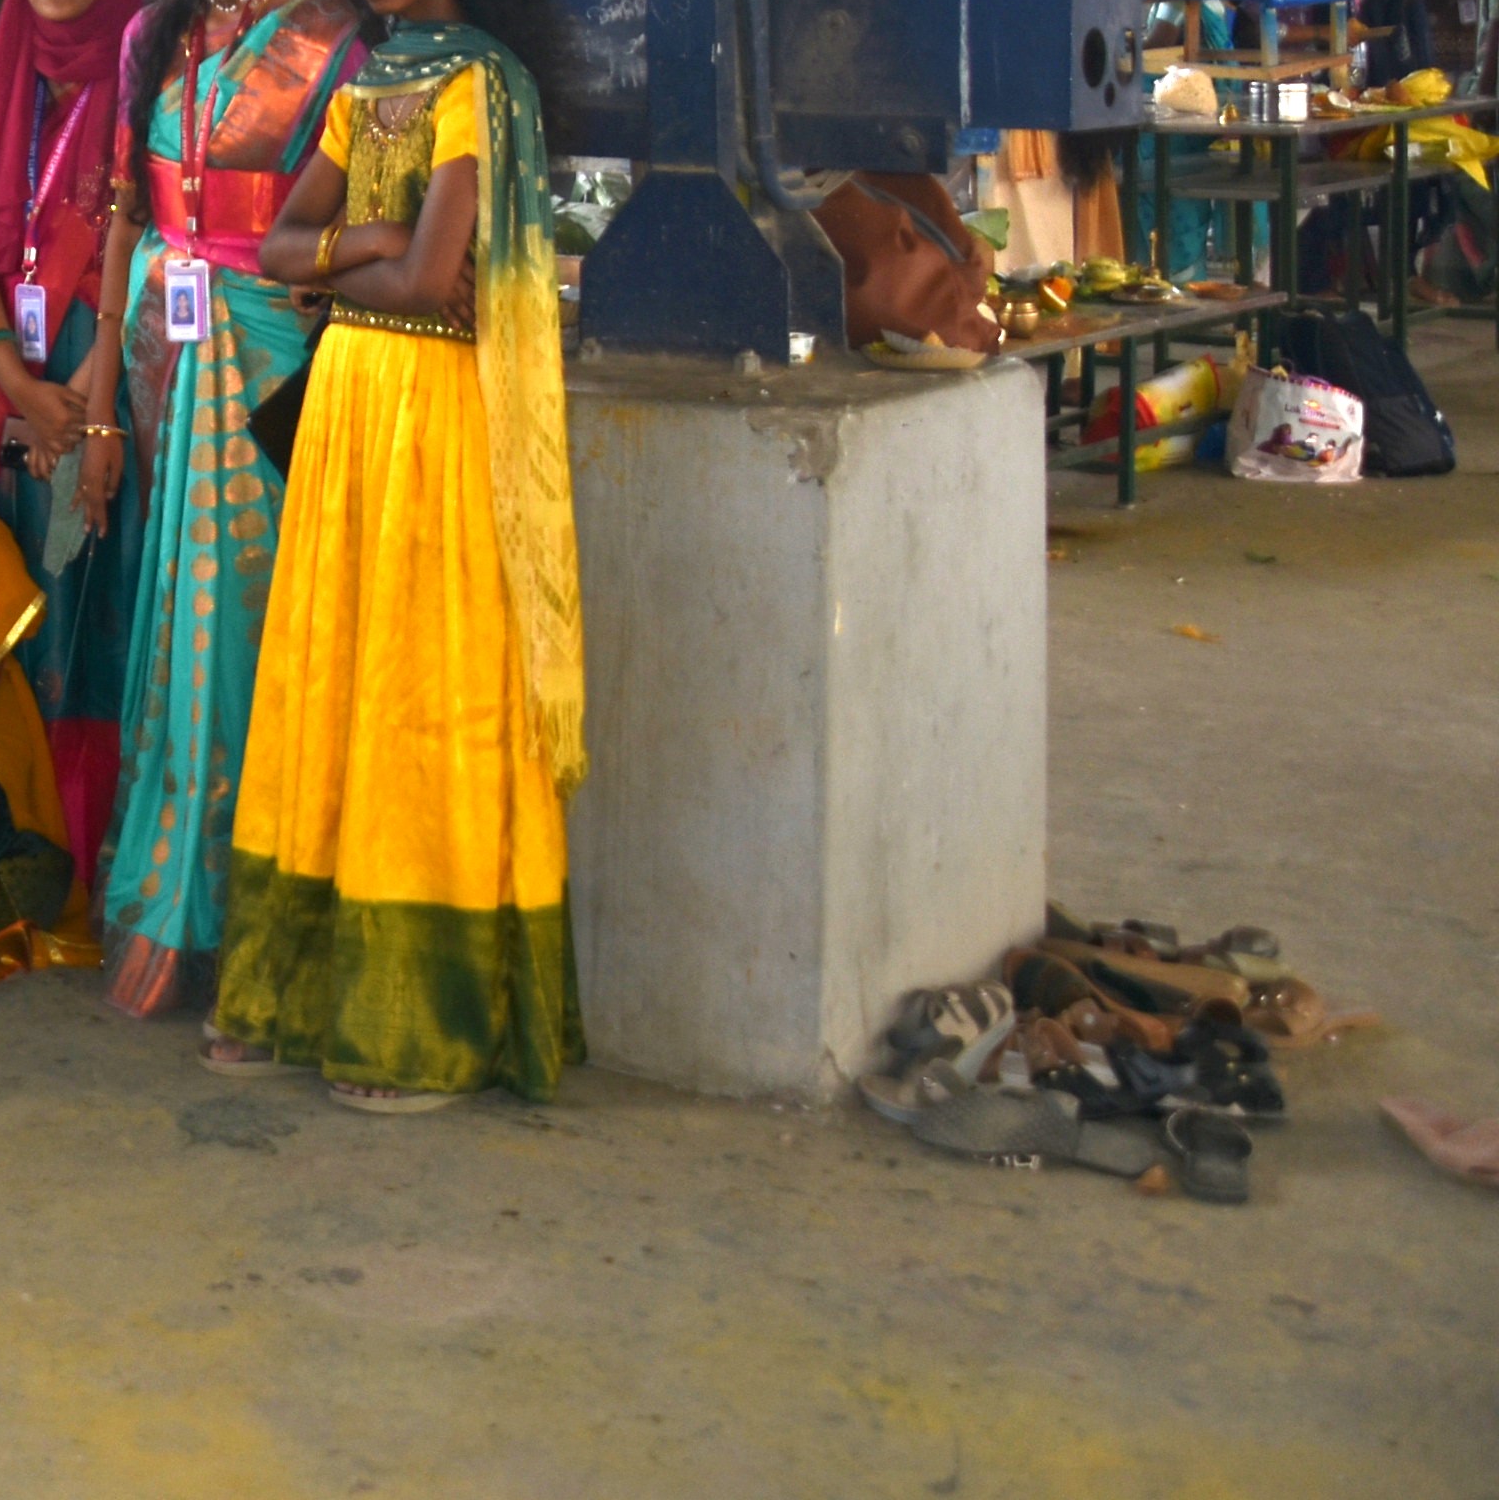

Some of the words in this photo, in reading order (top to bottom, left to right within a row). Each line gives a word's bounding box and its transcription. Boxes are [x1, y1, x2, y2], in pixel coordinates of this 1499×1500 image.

[47, 153, 60, 175] ARTS
[54, 136, 67, 155] AND
[61, 106, 81, 138] SCIENCE
